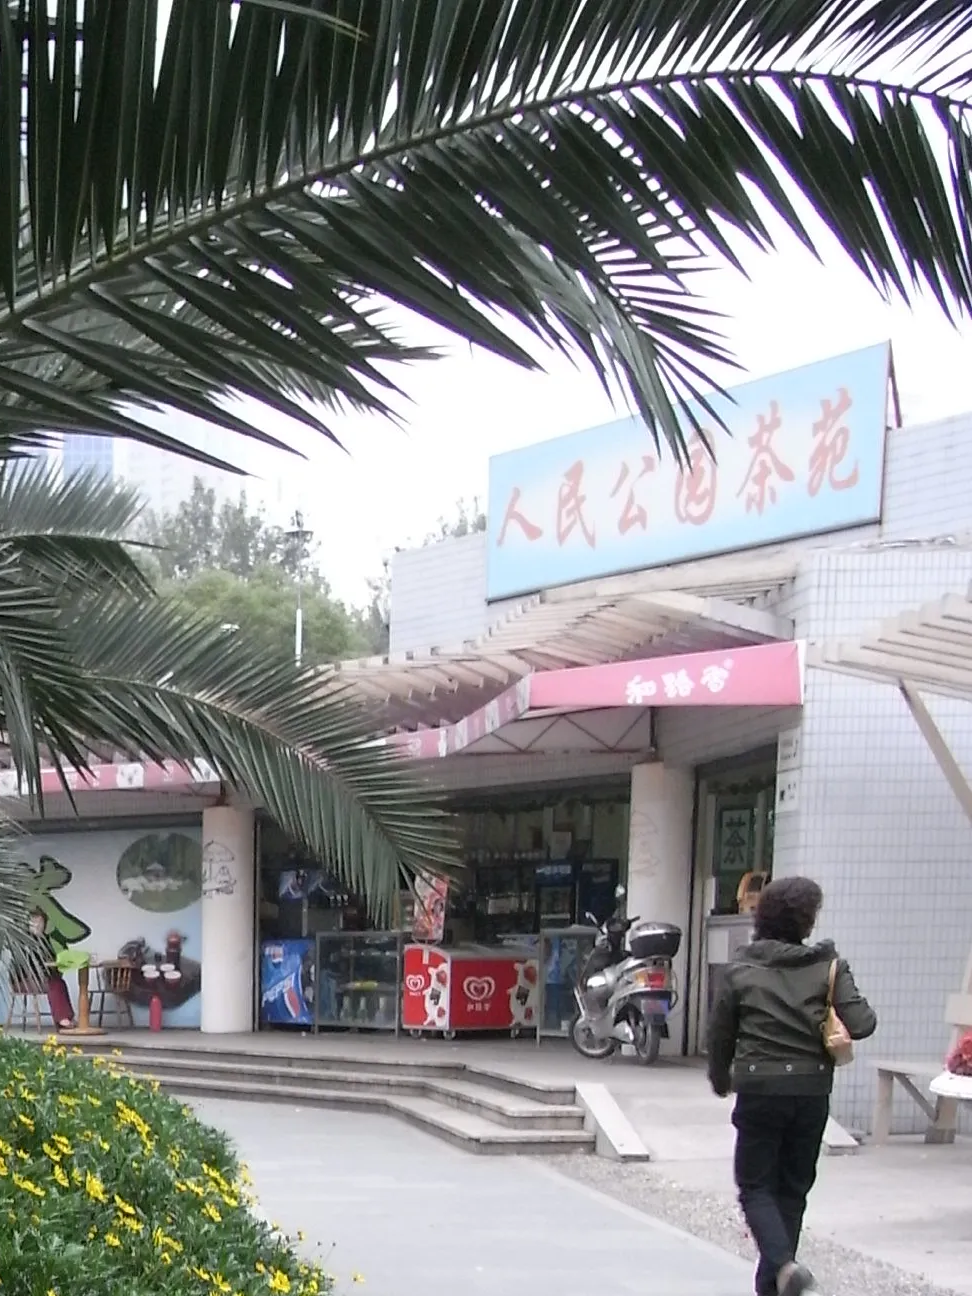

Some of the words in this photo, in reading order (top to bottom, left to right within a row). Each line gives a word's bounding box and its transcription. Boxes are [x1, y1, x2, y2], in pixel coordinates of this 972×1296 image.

[496, 388, 860, 548] 人民公园茶苑
